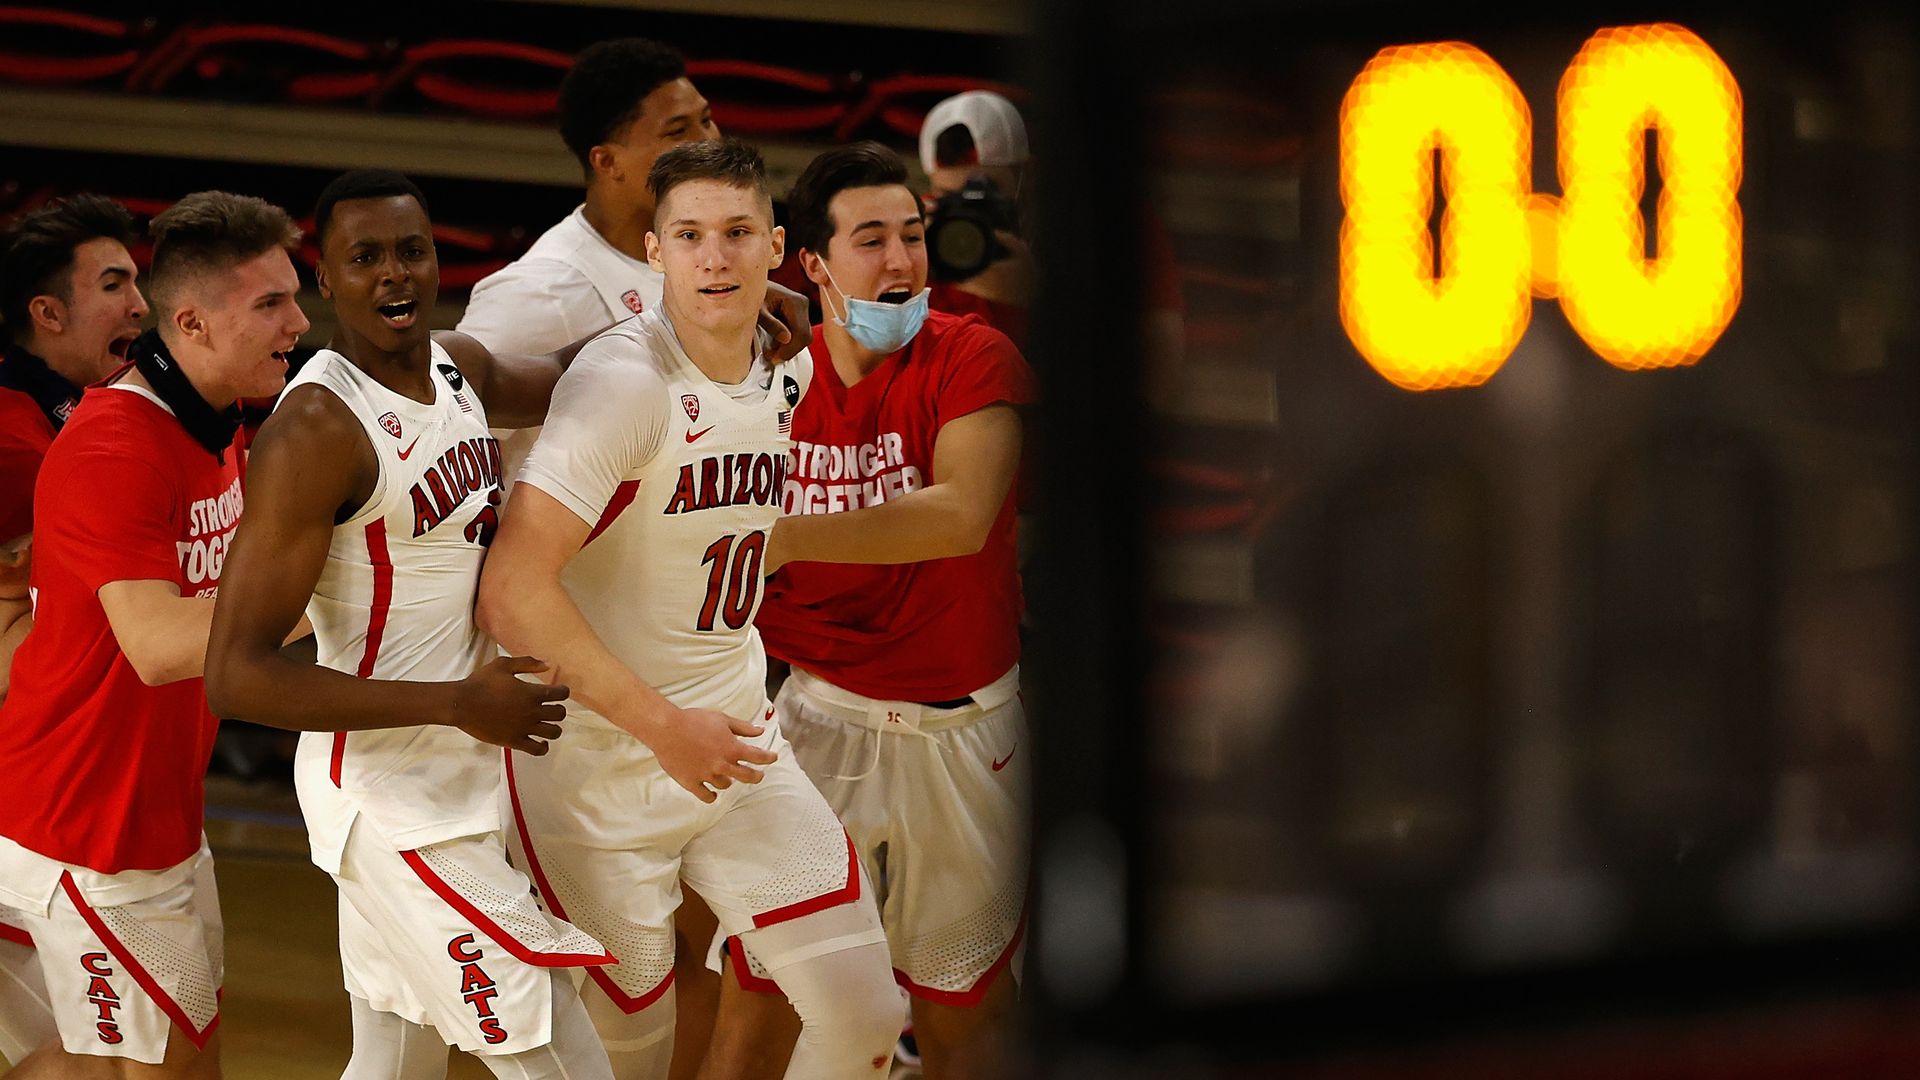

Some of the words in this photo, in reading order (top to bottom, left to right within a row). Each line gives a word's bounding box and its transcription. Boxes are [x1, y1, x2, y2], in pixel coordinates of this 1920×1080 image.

[408, 437, 506, 539] ARIZONA
[663, 452, 788, 515] ARIZON
[782, 465, 923, 516] OGETHER
[696, 530, 766, 632] 10
[80, 952, 123, 1045] CATS
[446, 932, 508, 1045] CATS
